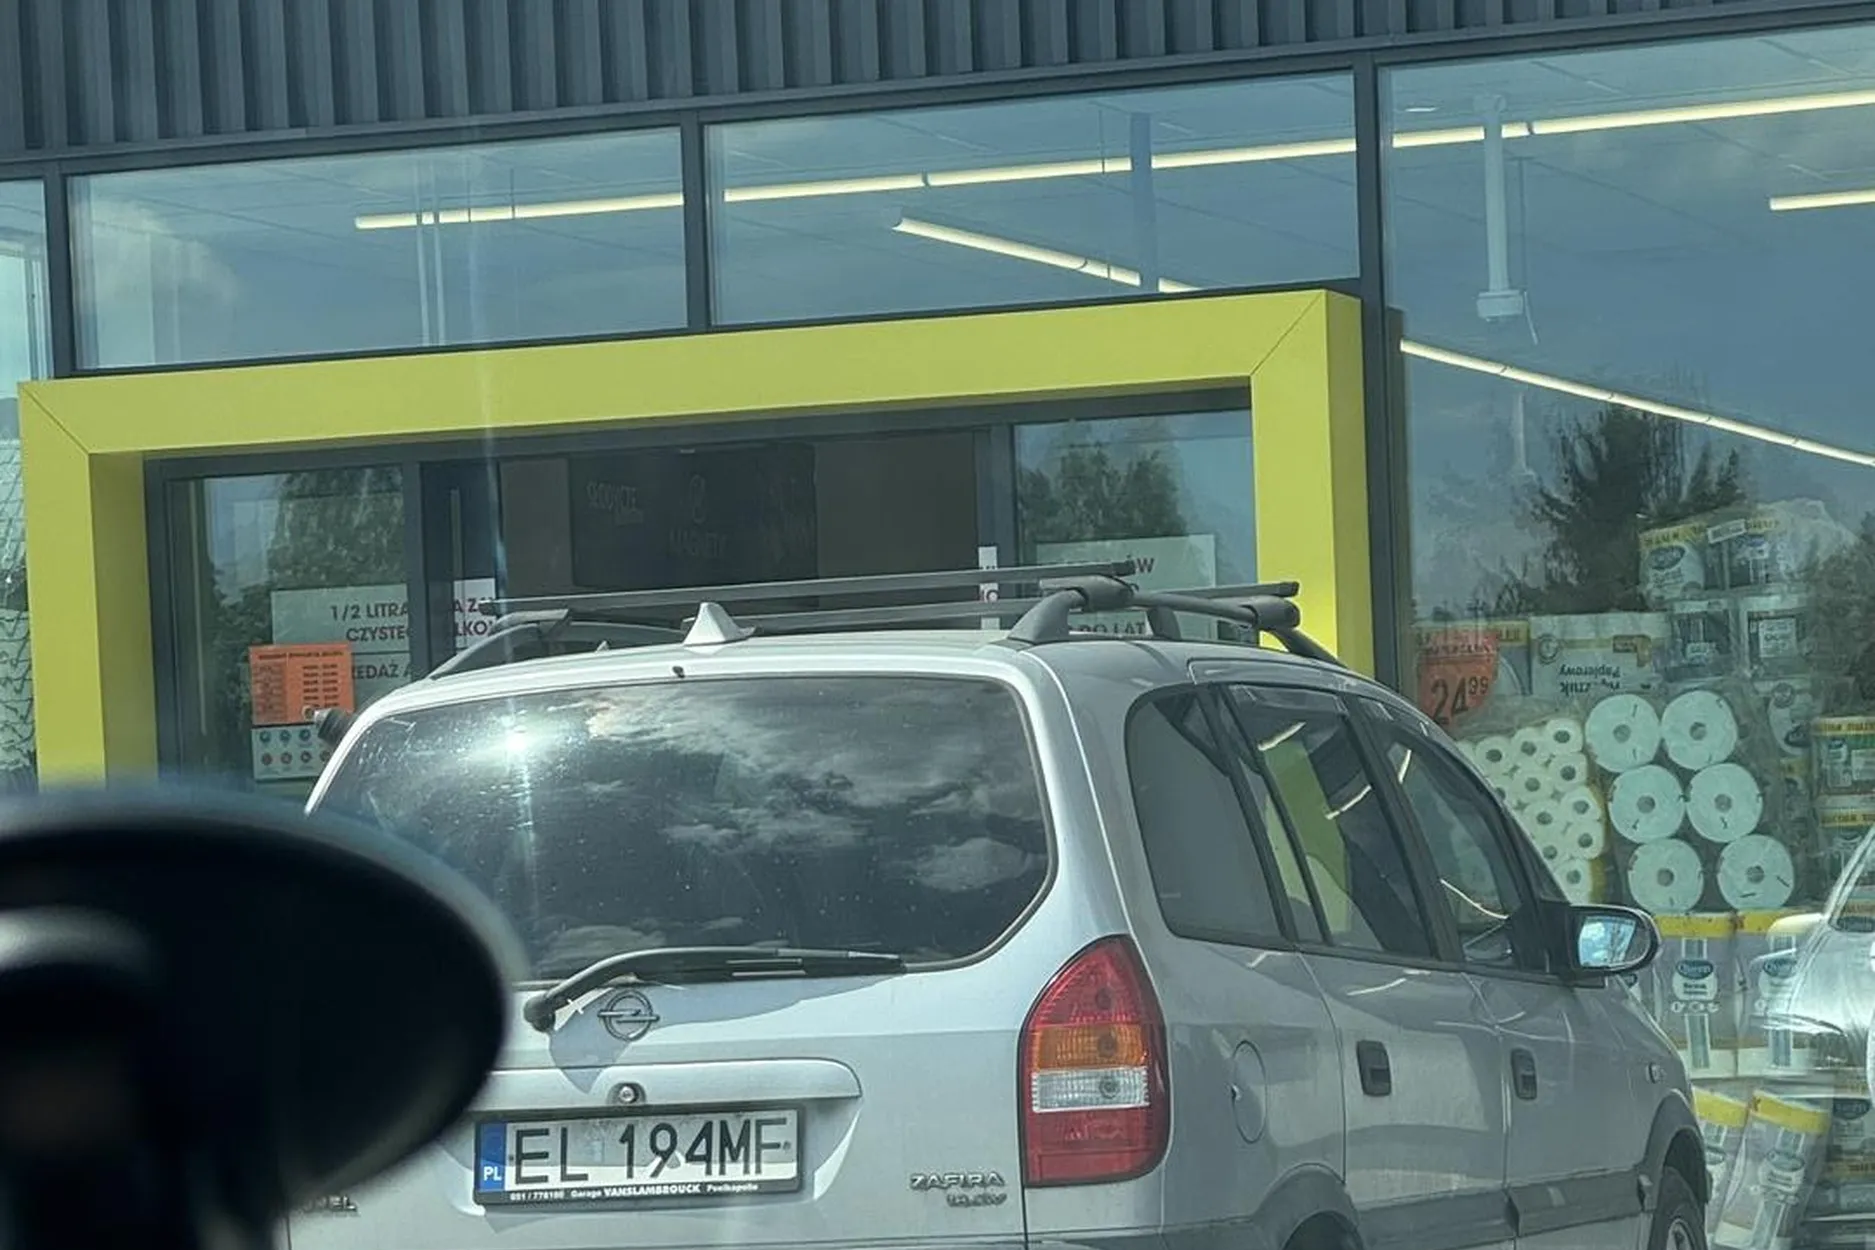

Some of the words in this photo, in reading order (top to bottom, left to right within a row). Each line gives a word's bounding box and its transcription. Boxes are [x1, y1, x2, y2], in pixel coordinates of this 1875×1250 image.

[331, 604, 361, 621] 1/2
[346, 625, 412, 642] CZYSTE
[1431, 676, 1468, 726] 24
[515, 1127, 589, 1185] EL
[618, 1117, 788, 1180] 194MF
[483, 1166, 502, 1181] PL
[910, 1171, 1005, 1191] ZAFIRA
[603, 1182, 701, 1197] VANSLAMBROUCK
